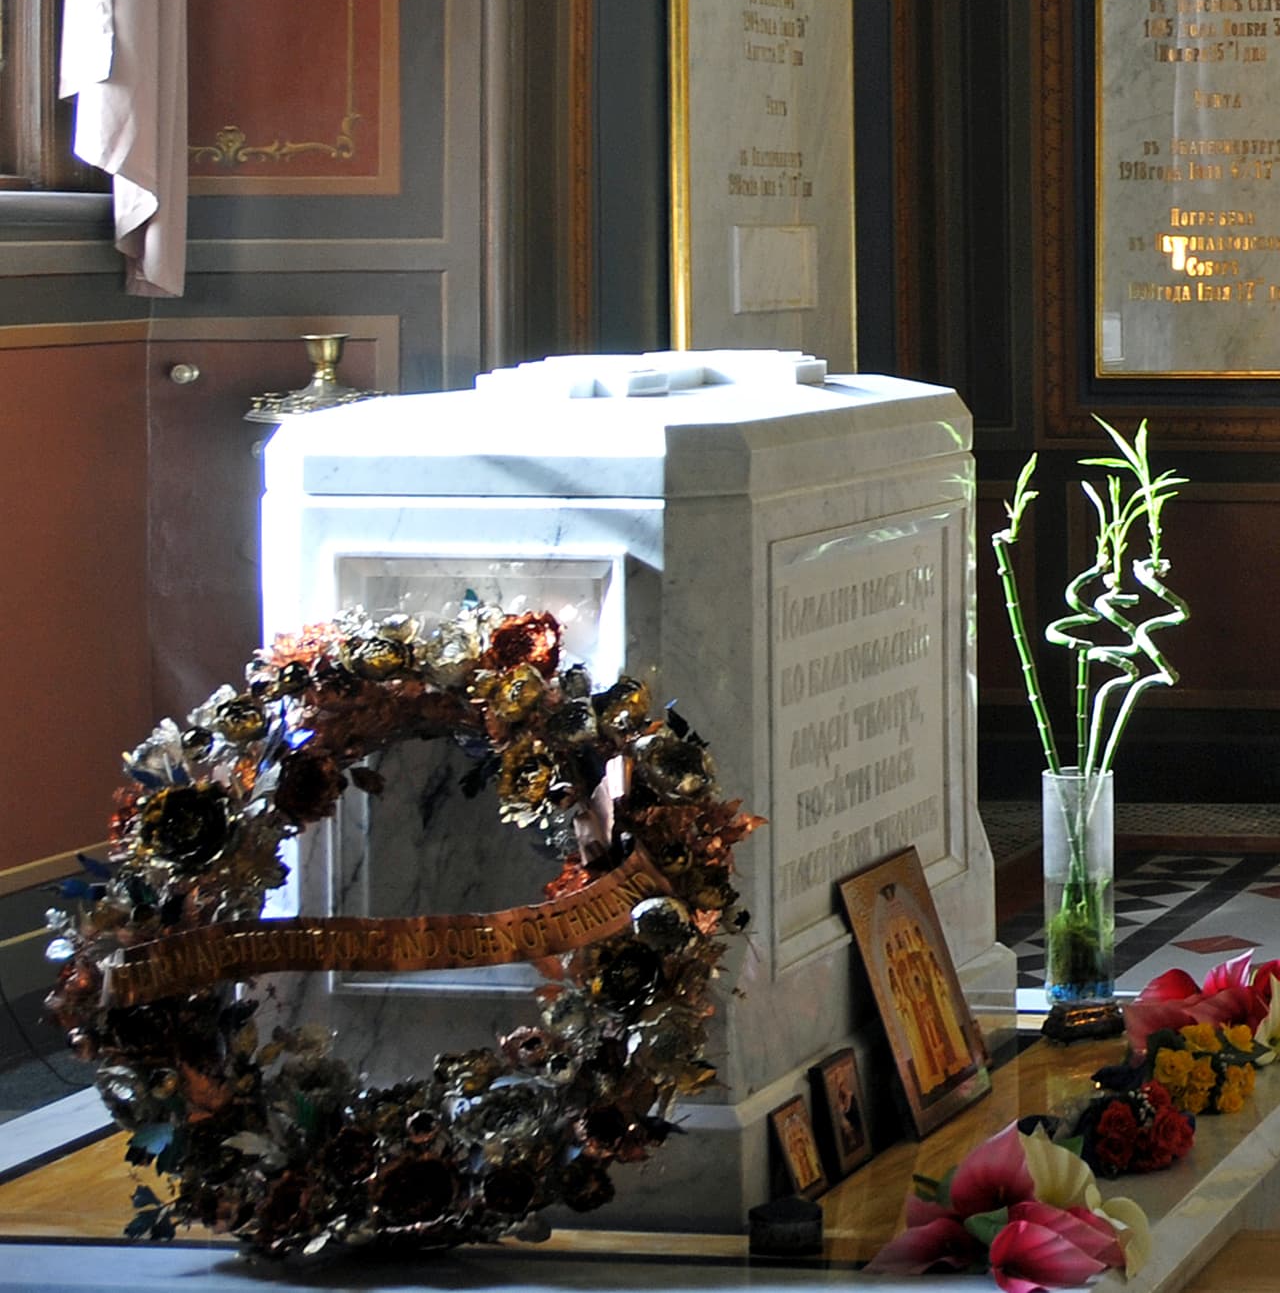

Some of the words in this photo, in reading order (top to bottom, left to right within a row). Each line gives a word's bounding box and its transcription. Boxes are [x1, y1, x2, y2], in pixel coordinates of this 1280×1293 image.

[331, 931, 386, 962] KING
[392, 929, 438, 961] AND
[445, 927, 517, 959] QUEEN
[519, 915, 549, 948] OF
[551, 871, 657, 942] THAILAND
